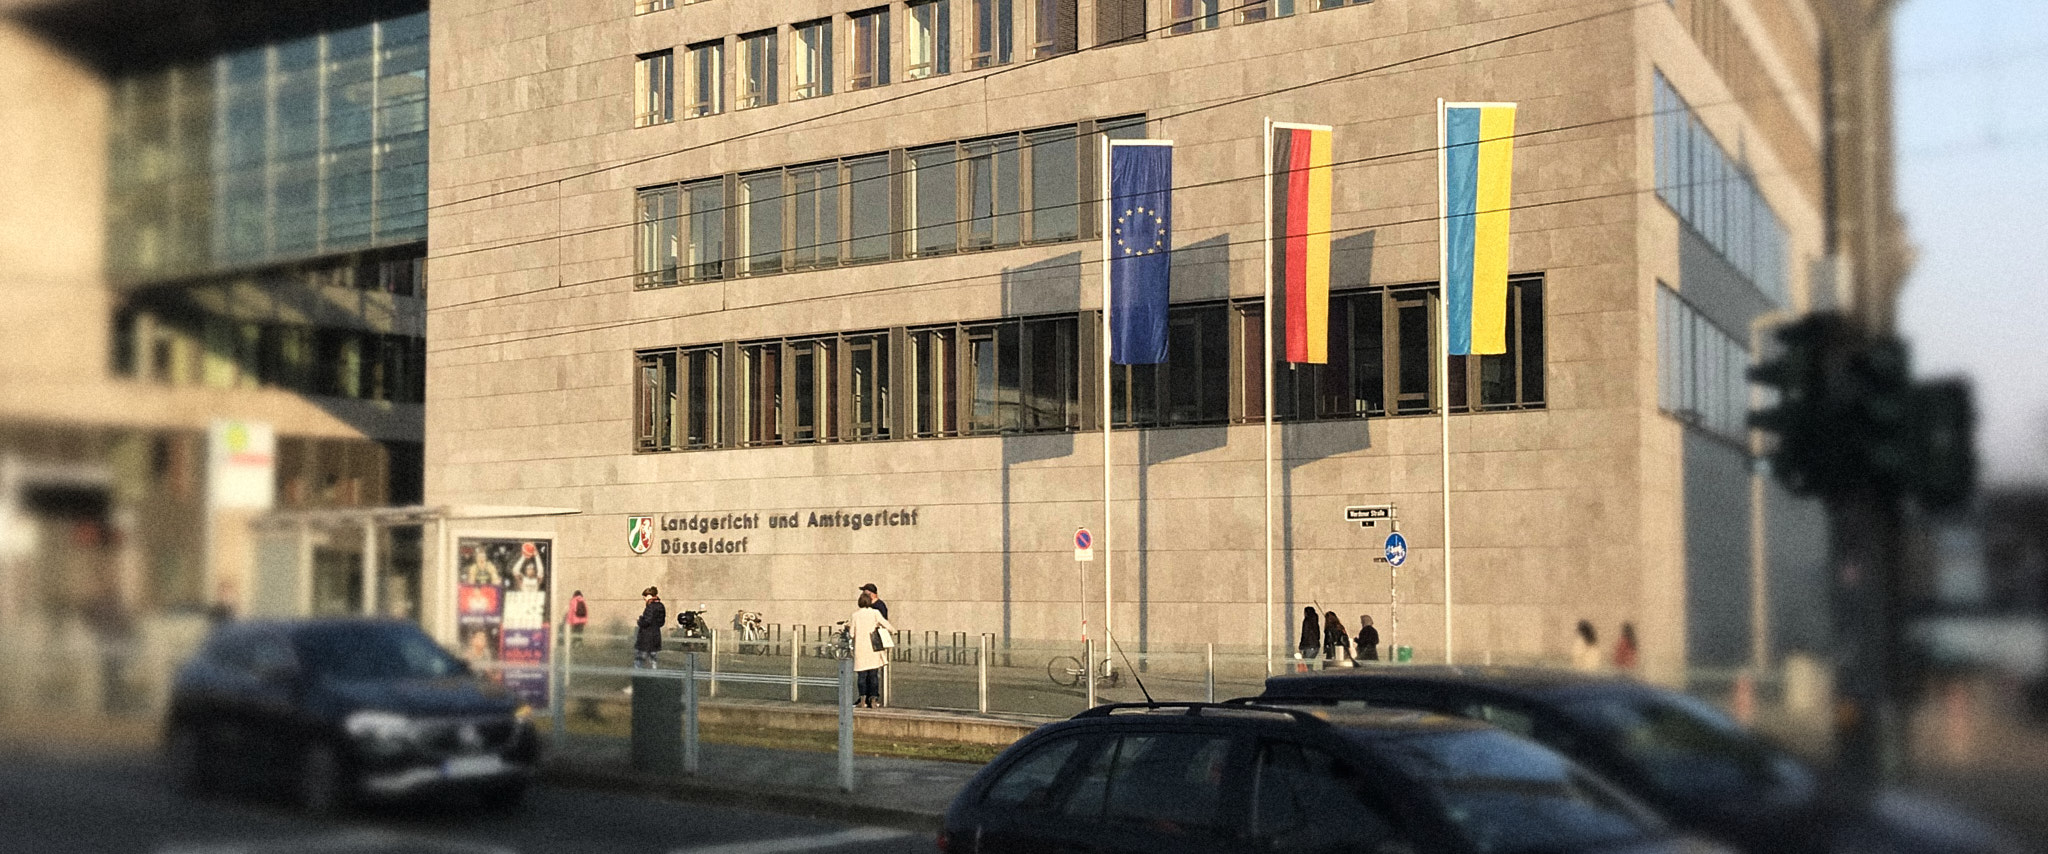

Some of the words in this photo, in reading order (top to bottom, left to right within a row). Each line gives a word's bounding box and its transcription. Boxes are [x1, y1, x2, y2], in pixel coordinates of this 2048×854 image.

[661, 513, 759, 534] Landgericht
[769, 512, 798, 528] und
[807, 509, 918, 530] Amtsgericht
[661, 537, 748, 554] Düsseldorf
